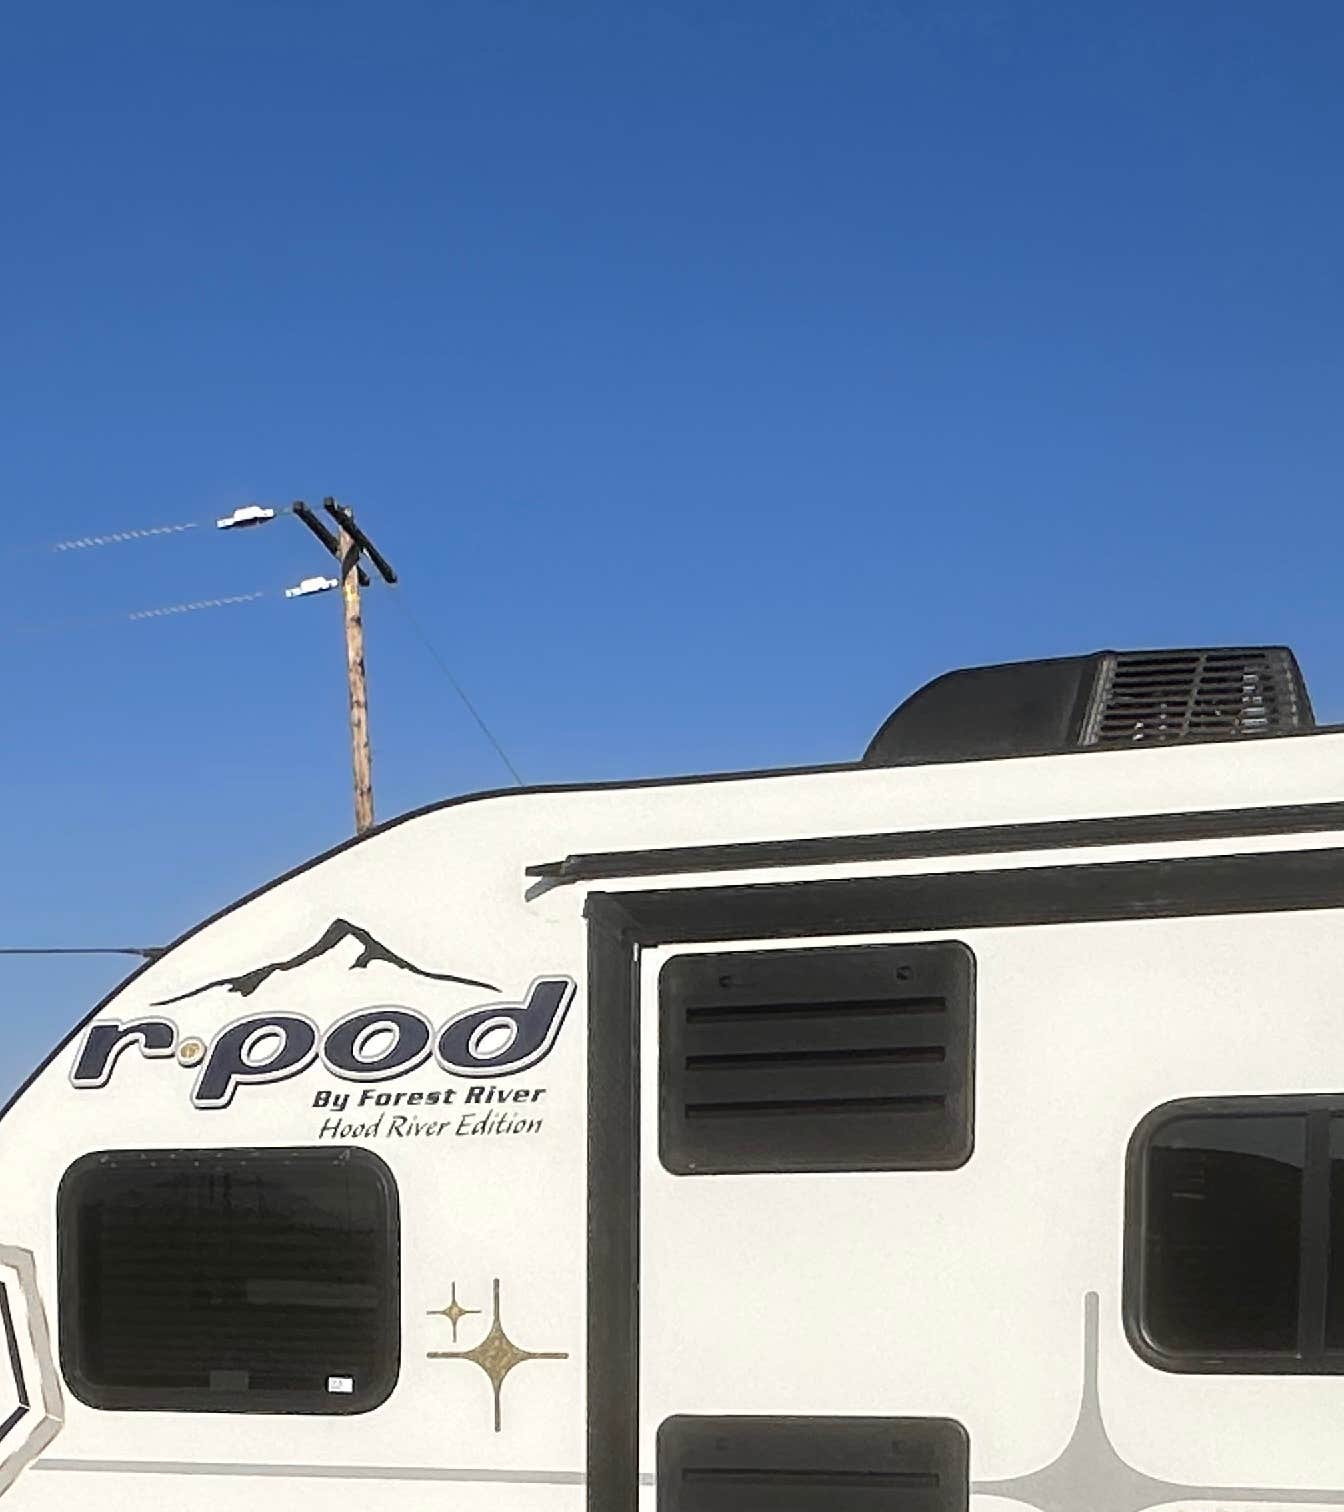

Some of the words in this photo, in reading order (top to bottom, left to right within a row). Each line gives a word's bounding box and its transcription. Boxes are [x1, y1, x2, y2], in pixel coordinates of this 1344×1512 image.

[312, 1090, 349, 1112] By
[357, 1088, 456, 1107] Forest
[464, 1086, 546, 1104] River
[318, 1112, 386, 1139] Hood
[388, 1114, 452, 1138] River
[455, 1109, 544, 1136] Edition
